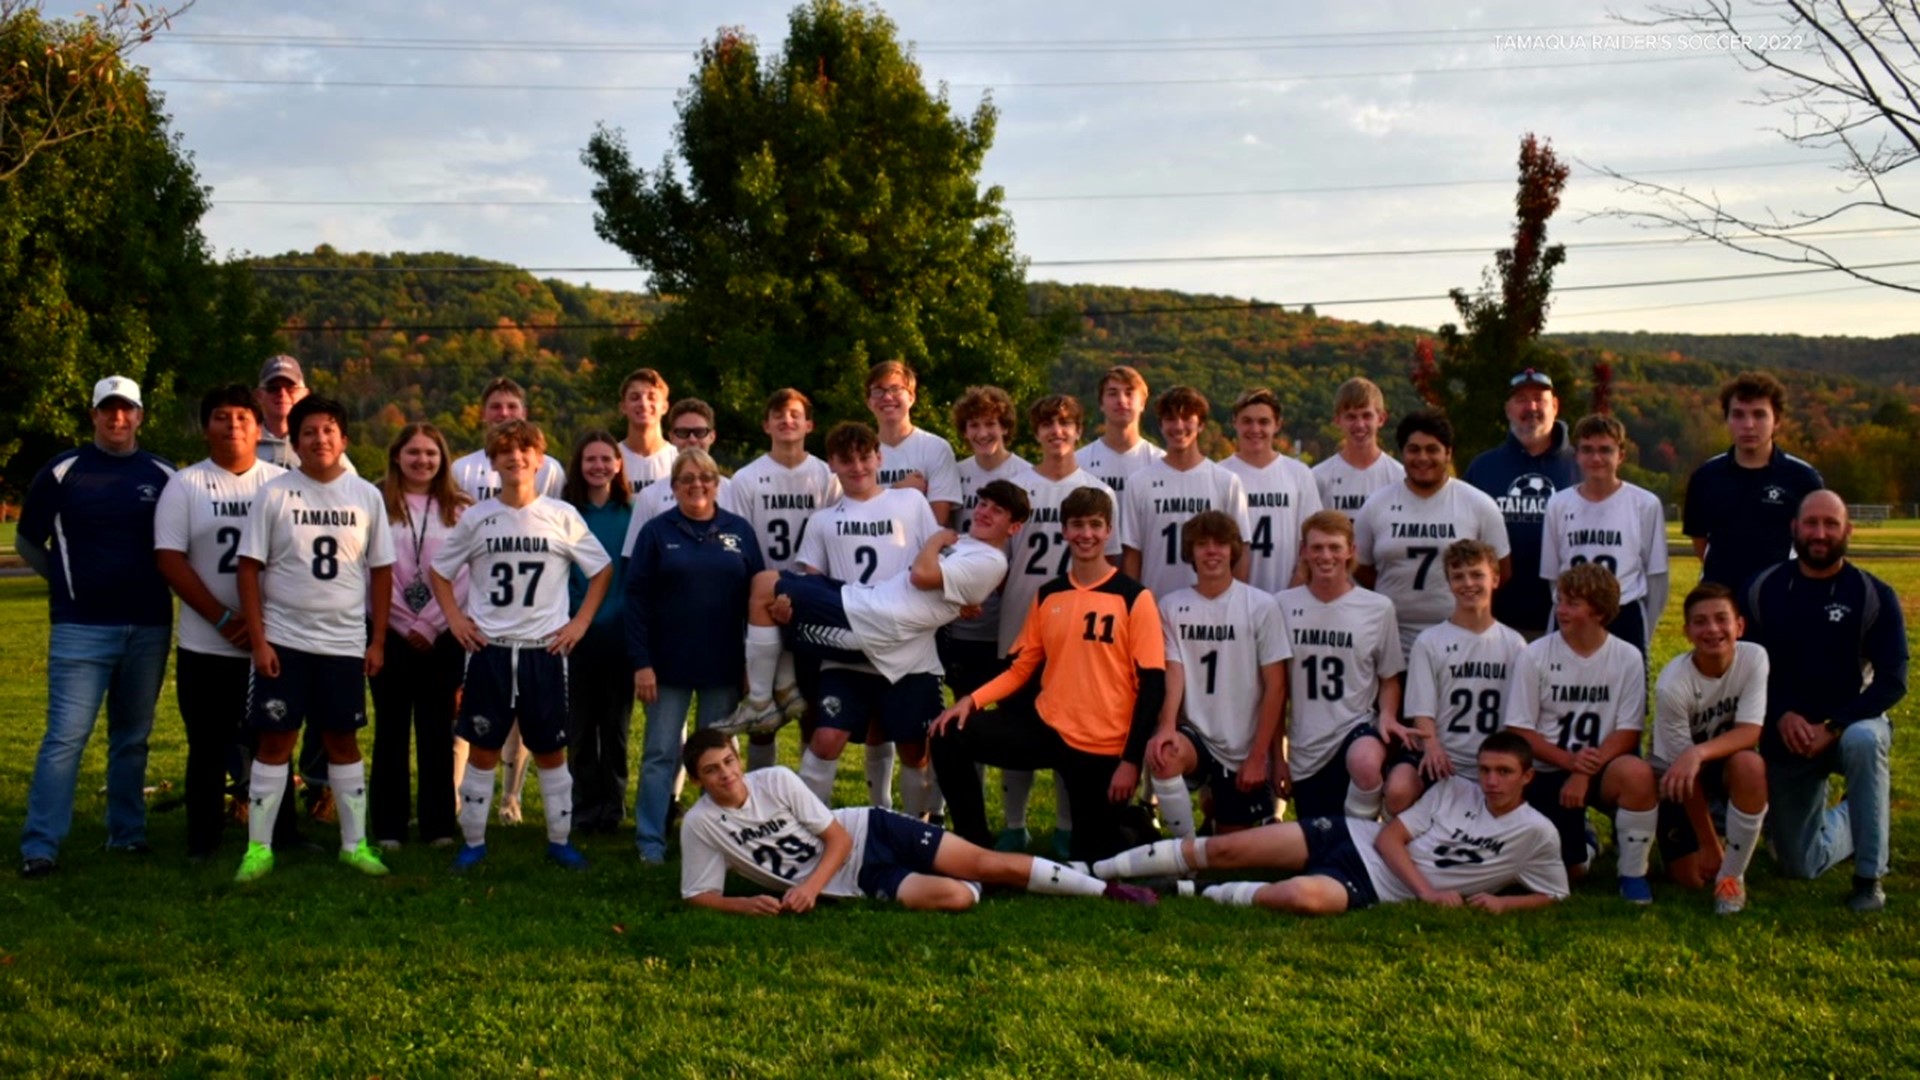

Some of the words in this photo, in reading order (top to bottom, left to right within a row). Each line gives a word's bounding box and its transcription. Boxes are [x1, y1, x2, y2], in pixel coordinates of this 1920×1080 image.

[212, 501, 253, 517] TAMA
[292, 509, 358, 526] TAMAQUA
[763, 494, 816, 510] TAMAQUA
[1247, 493, 1290, 508] MAQUA
[486, 537, 549, 553] TAMAQUA
[836, 519, 894, 538] TAMAQUA
[1161, 522, 1178, 566] 1
[1391, 522, 1457, 539] TAMAQUA
[216, 526, 242, 575] 2
[311, 535, 339, 580] 8
[854, 545, 878, 585] 2
[489, 561, 546, 609] 37
[1406, 546, 1439, 591] 7
[1082, 611, 1116, 645] 11
[1179, 624, 1236, 641] TAMAQUA
[1292, 629, 1354, 648] TAMAQUA
[1200, 650, 1218, 695] 1
[1301, 654, 1345, 701] 13
[1449, 661, 1507, 680] TAMAQUA
[1551, 685, 1610, 703] TAMAQUA
[1447, 688, 1501, 735] 28
[1555, 710, 1601, 751] 19
[752, 834, 817, 881] 29
